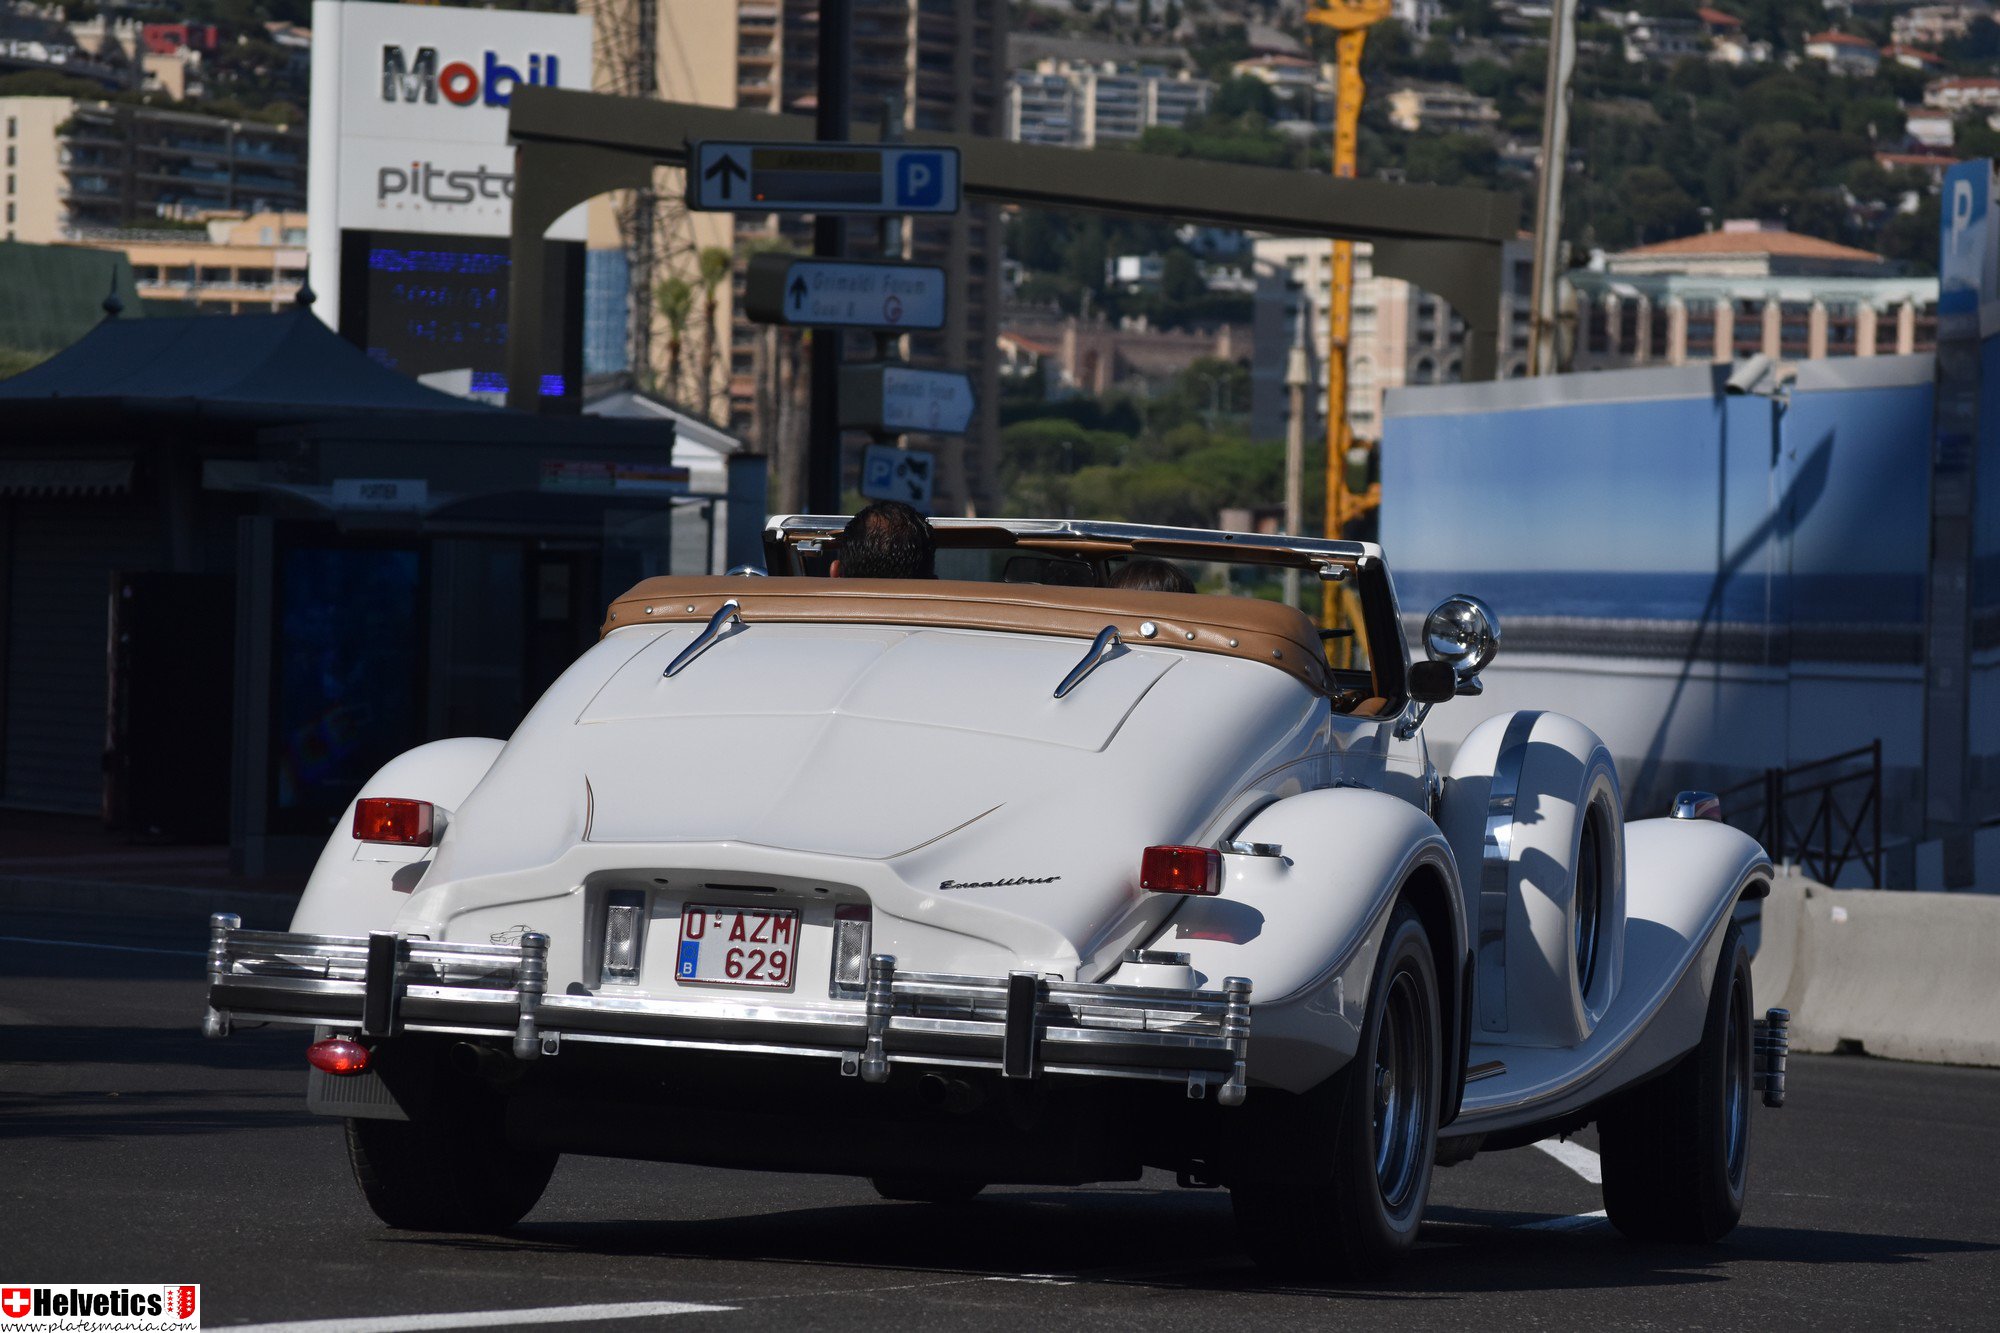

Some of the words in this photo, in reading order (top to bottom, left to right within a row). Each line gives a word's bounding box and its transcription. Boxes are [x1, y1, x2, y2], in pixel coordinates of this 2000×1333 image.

[383, 44, 558, 107] Mobil
[907, 163, 932, 197] P
[1951, 179, 1973, 255] P
[938, 875, 1062, 890] Excalibur
[682, 961, 693, 975] B
[725, 946, 788, 981] 629
